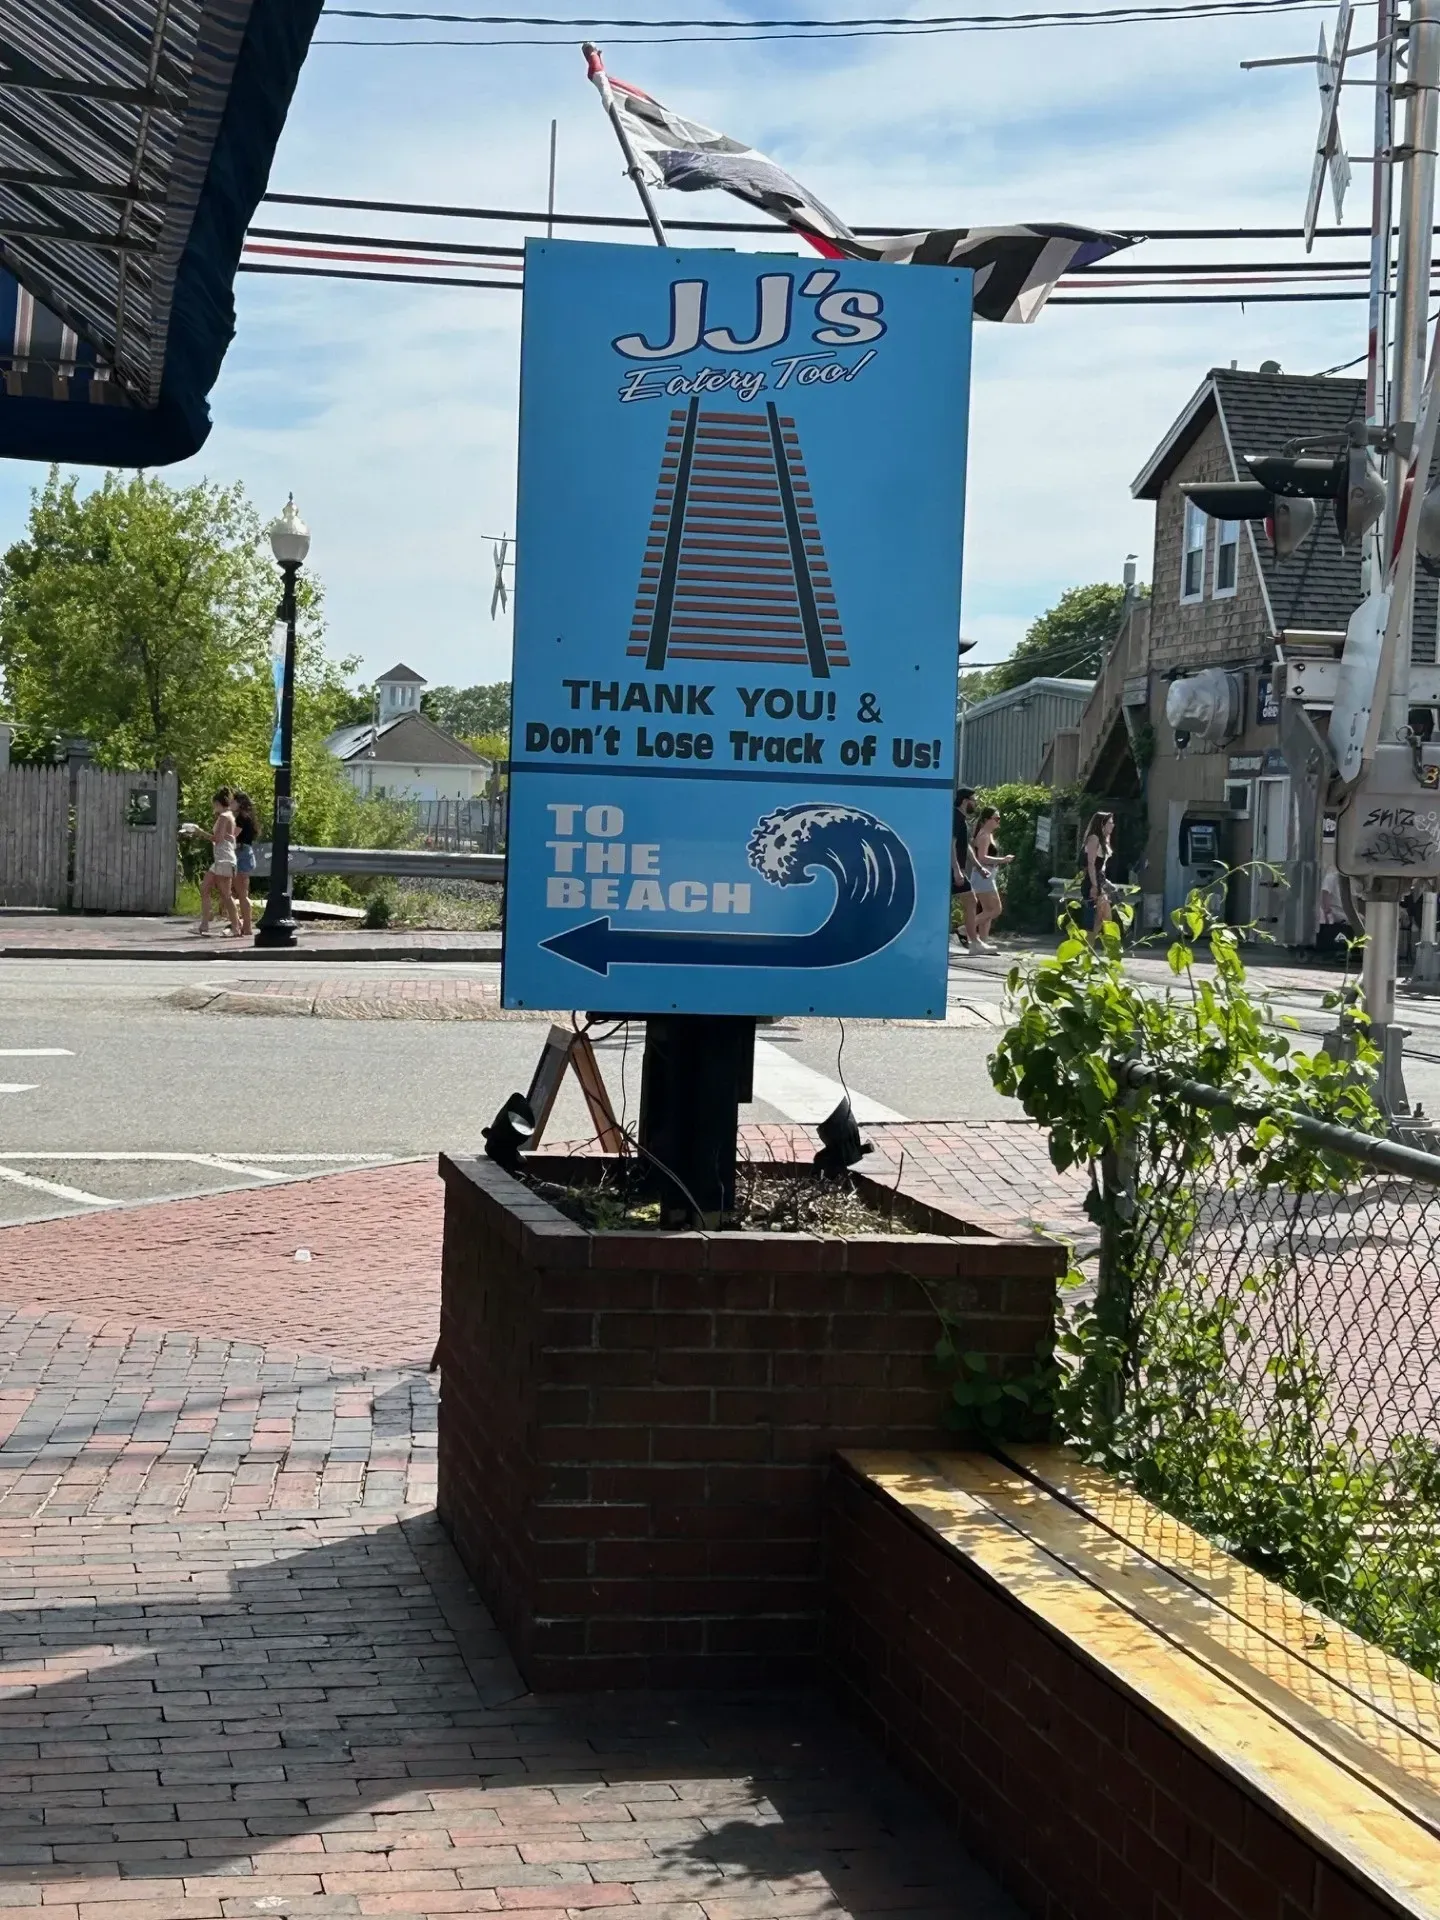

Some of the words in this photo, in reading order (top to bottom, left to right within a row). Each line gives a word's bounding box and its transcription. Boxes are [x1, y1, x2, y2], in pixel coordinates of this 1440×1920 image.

[611, 268, 887, 361] JJ's
[618, 364, 768, 402] Eatery
[771, 349, 878, 390] Too!
[562, 679, 716, 716] THANK
[736, 687, 836, 722] YOU!
[857, 692, 884, 724] &
[525, 722, 621, 756] Don't
[636, 726, 714, 760] Lose
[729, 730, 826, 764] Track
[840, 735, 877, 766] of
[892, 737, 942, 770] Us!
[546, 803, 624, 837] TO
[545, 841, 660, 875] THE
[546, 876, 752, 914] BEACH
